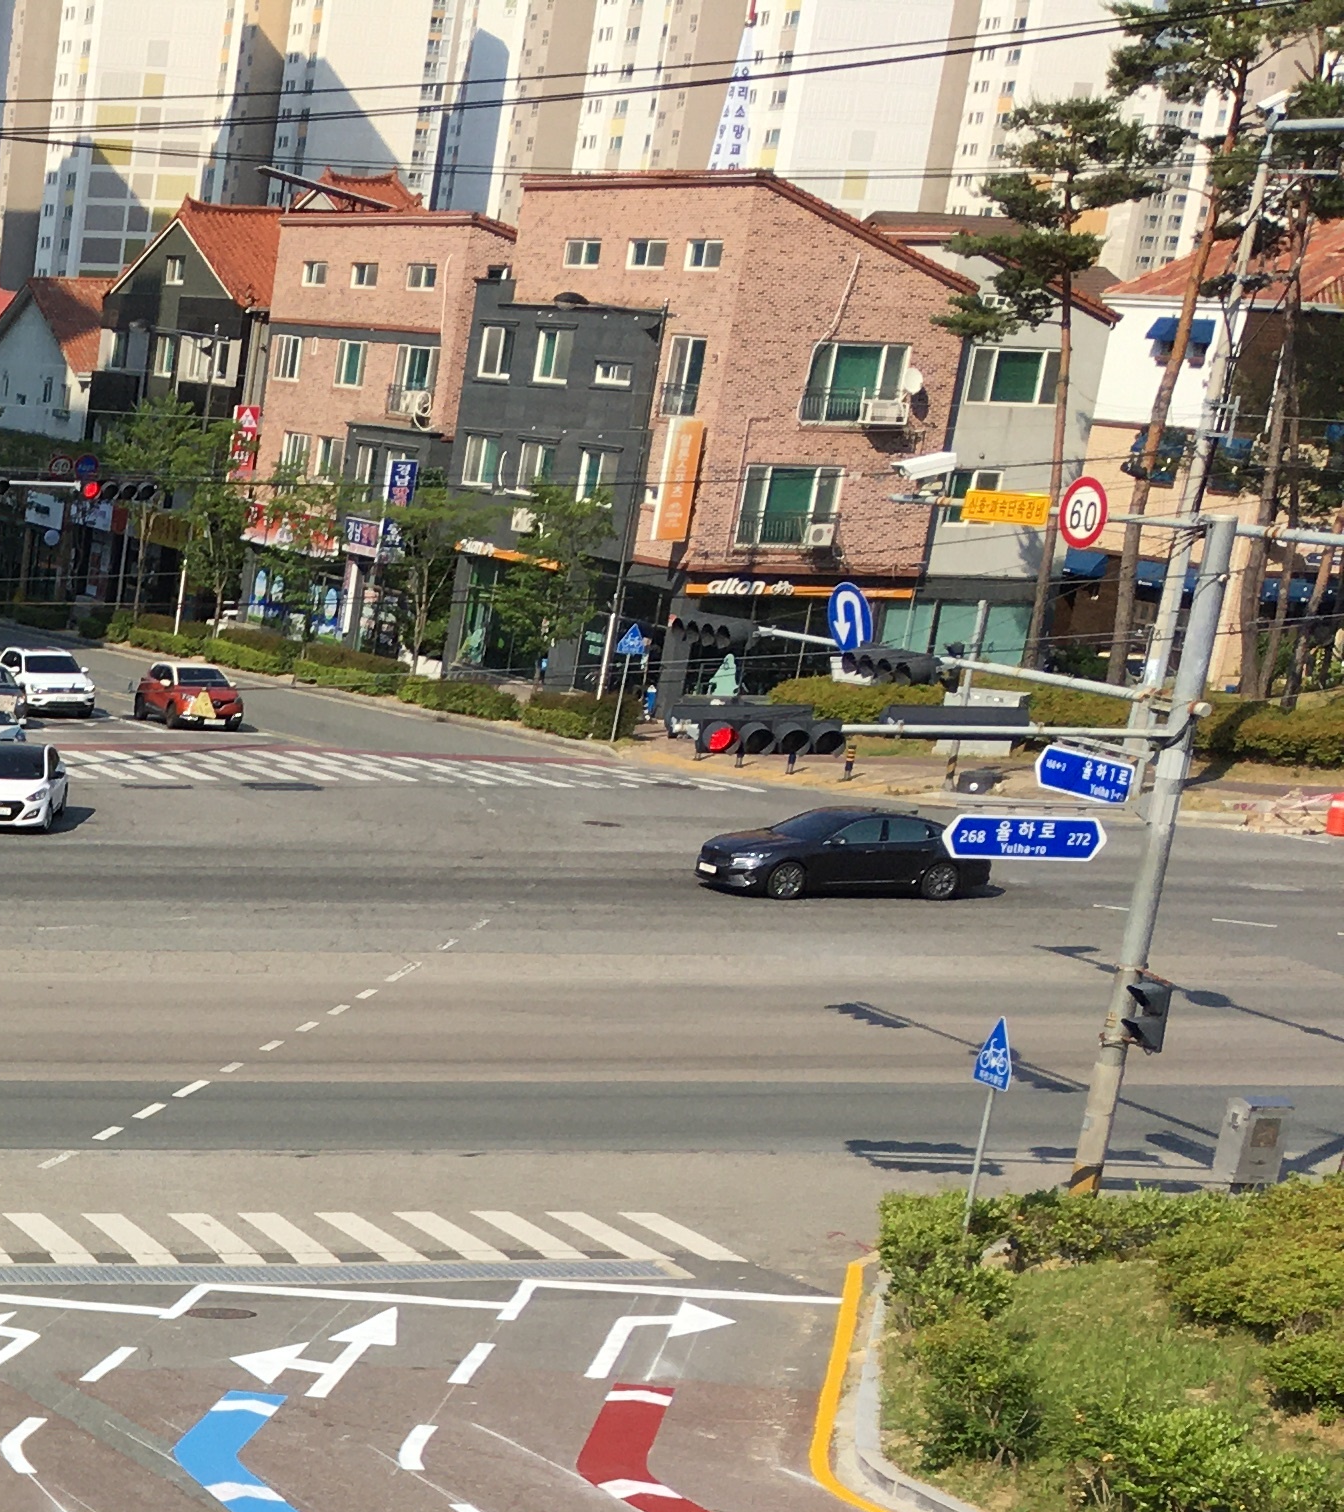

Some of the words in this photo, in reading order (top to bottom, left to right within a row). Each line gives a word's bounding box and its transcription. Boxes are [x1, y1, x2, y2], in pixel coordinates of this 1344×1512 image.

[1069, 499, 1097, 532] 60
[707, 577, 766, 595] alton
[1082, 760, 1129, 786] 율하1로
[959, 829, 987, 844] 268
[995, 821, 1056, 842] 율하로
[1066, 832, 1091, 847] 272
[1000, 843, 1047, 856] Yulha-ro
